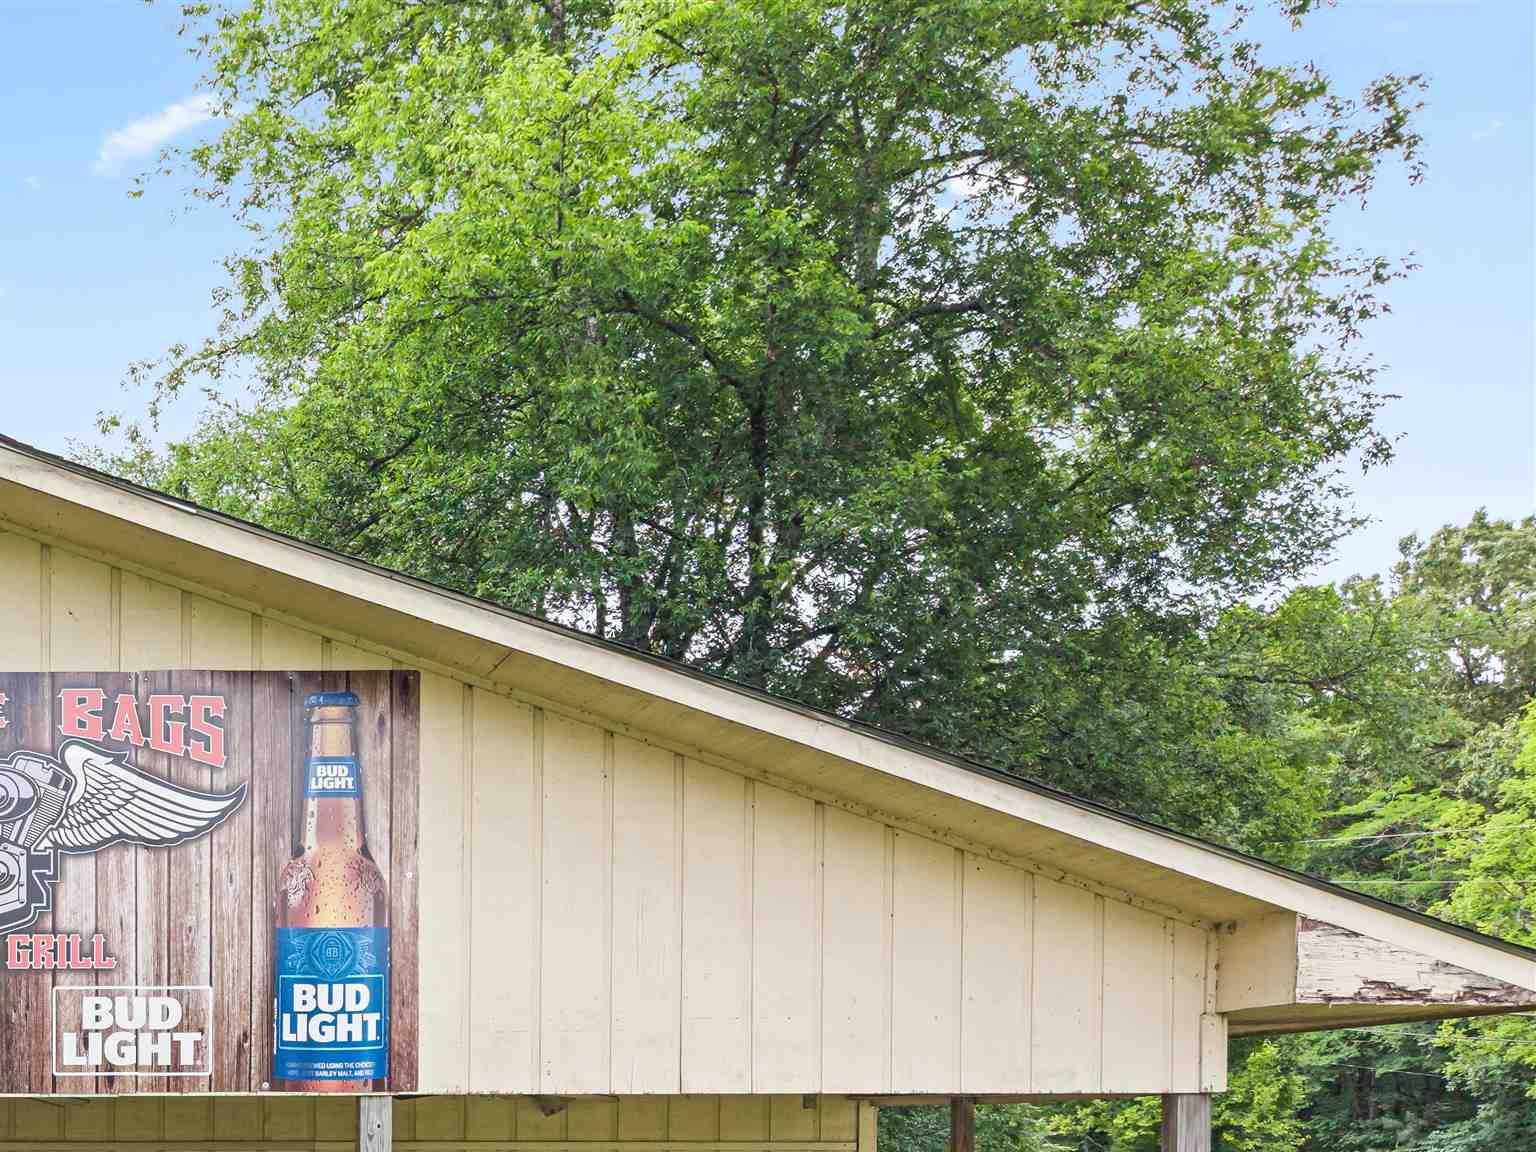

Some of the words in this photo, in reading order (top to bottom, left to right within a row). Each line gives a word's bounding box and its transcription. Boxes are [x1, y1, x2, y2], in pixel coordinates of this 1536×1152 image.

[57, 688, 227, 768] BAGS
[310, 777, 354, 789] LIGHT
[316, 765, 349, 777] BUD
[6, 934, 117, 970] GRILL
[293, 983, 370, 1012] BUD
[82, 997, 182, 1030] BUD
[283, 1013, 381, 1042] LIGHT
[64, 1031, 202, 1066] LIGHT
